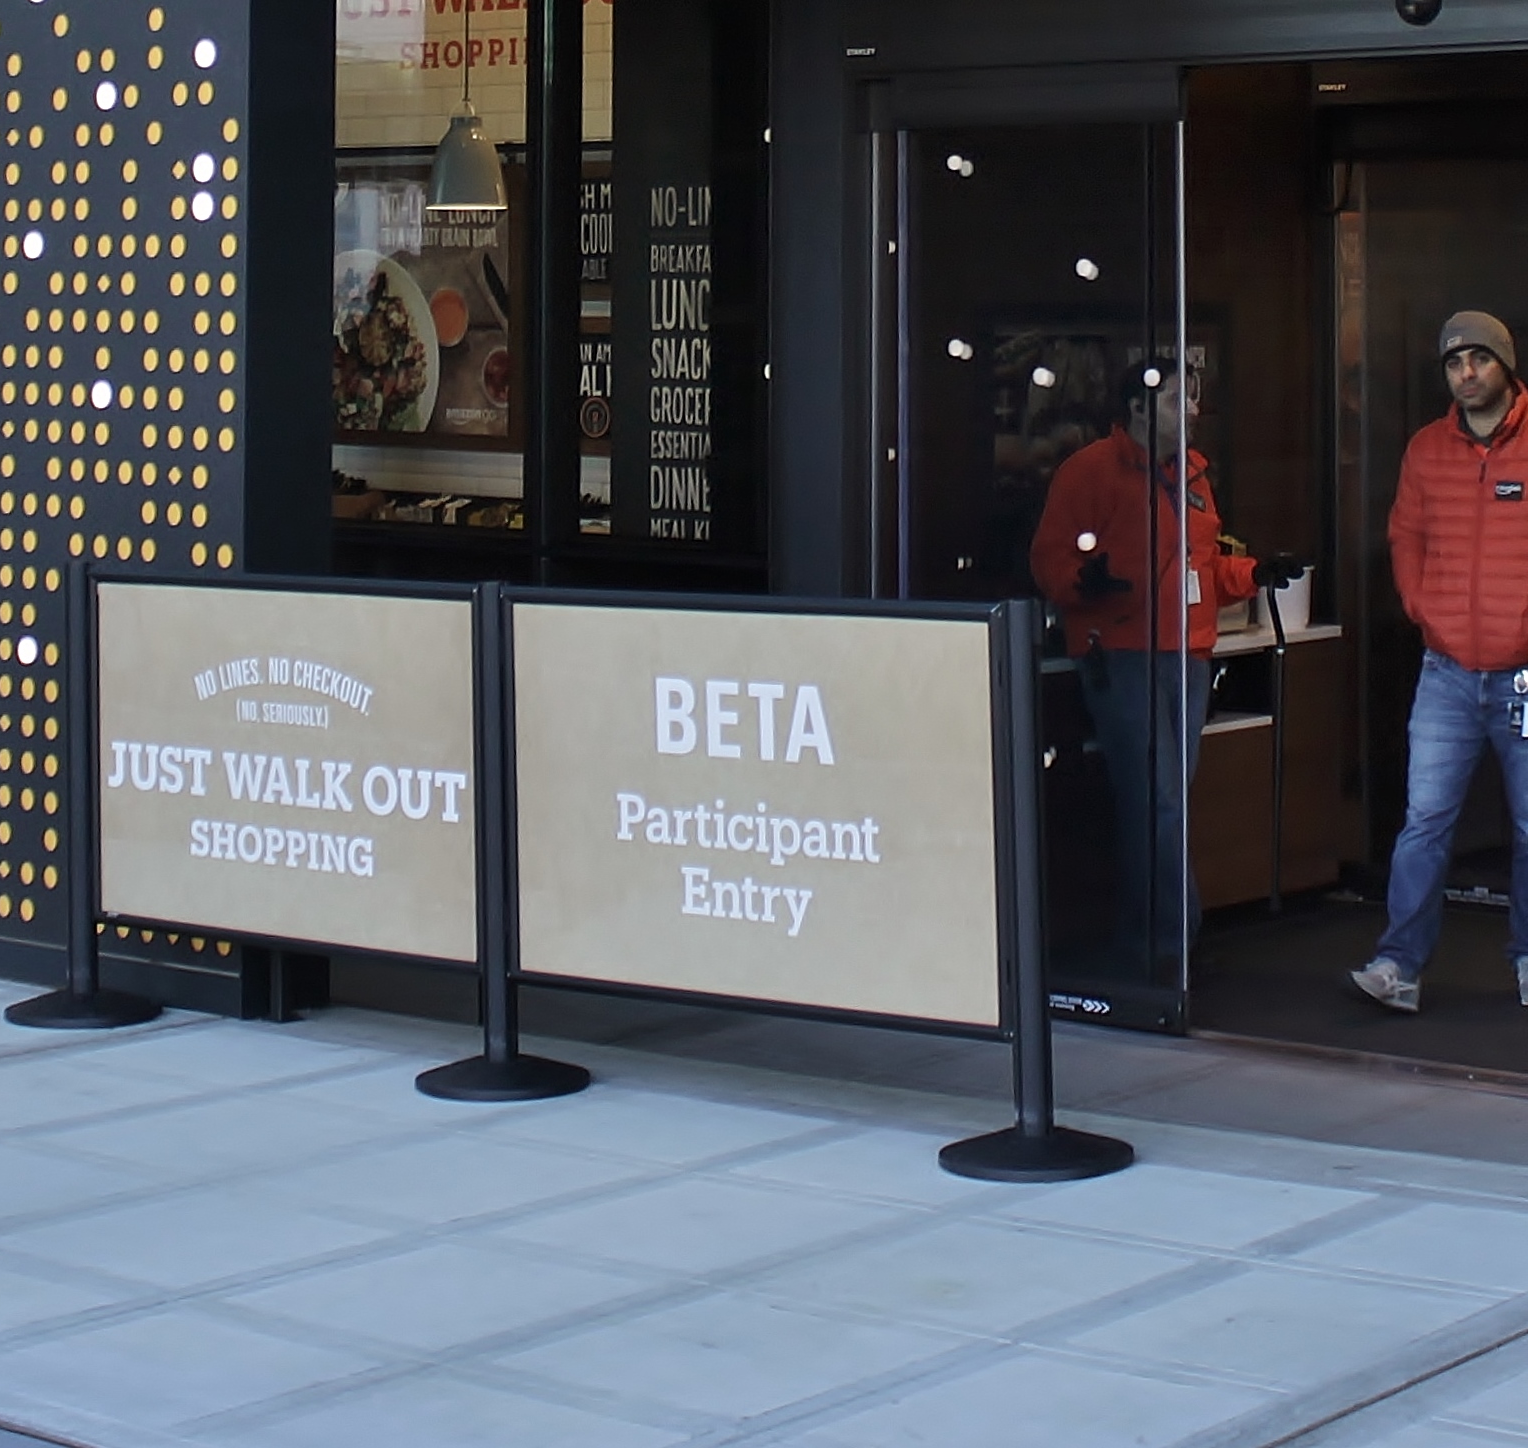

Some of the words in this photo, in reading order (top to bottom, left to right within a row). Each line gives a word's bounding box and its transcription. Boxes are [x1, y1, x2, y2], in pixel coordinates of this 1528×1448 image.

[193, 669, 217, 701] NO
[218, 657, 264, 691] LINES.
[268, 657, 289, 685] NO
[293, 660, 373, 717] CHECKOUT.
[654, 676, 836, 766] BETA
[107, 740, 213, 797] JUST
[222, 751, 354, 813] WALK
[361, 765, 467, 824] OUT
[189, 818, 374, 878] SHOPPING
[614, 791, 882, 867] Participant
[680, 866, 813, 938] Entry
